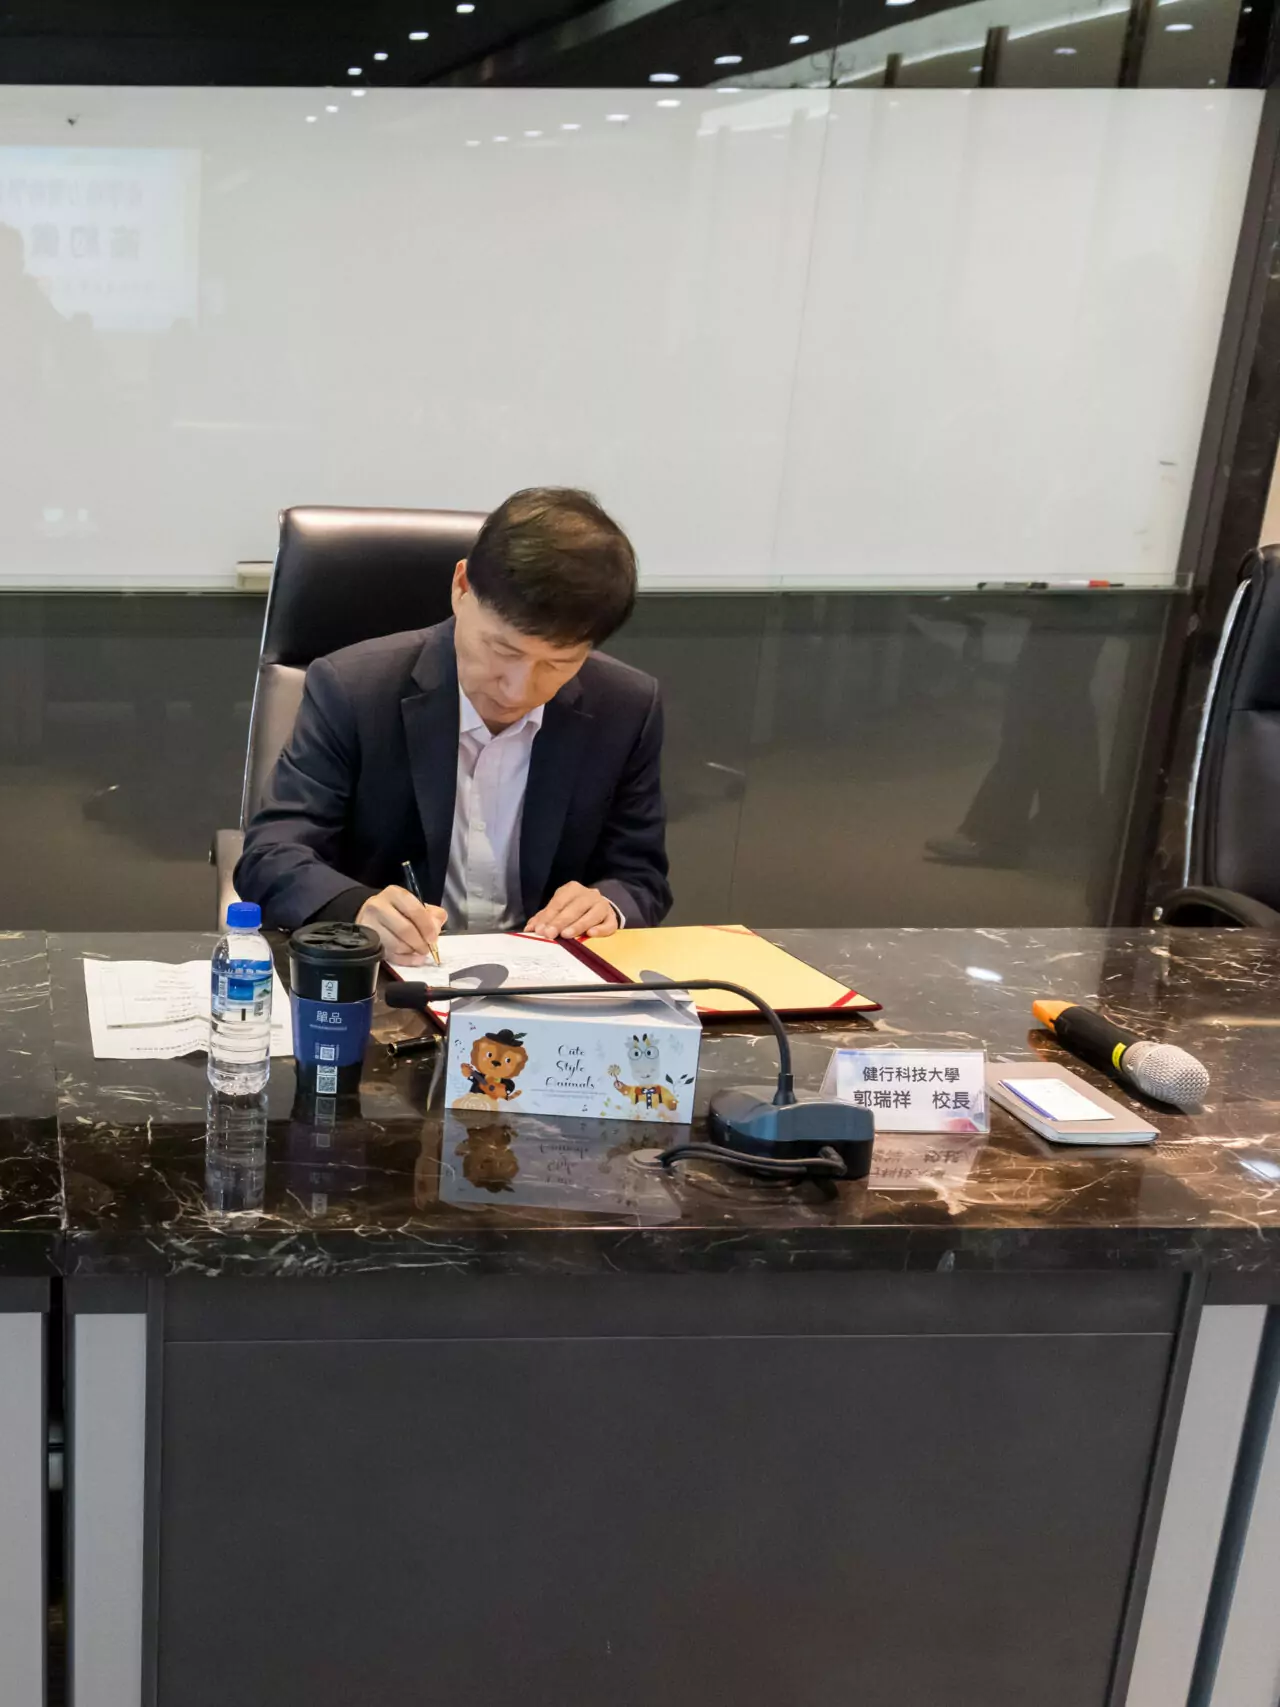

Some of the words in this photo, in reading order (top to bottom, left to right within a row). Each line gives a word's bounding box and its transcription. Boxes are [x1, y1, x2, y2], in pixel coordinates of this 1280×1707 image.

[556, 1059, 584, 1077] Style
[863, 1067, 960, 1083] 健行科技大學
[545, 1076, 595, 1089] Animals
[853, 1090, 912, 1109] 郭瑞祥
[932, 1091, 971, 1109] 校長
